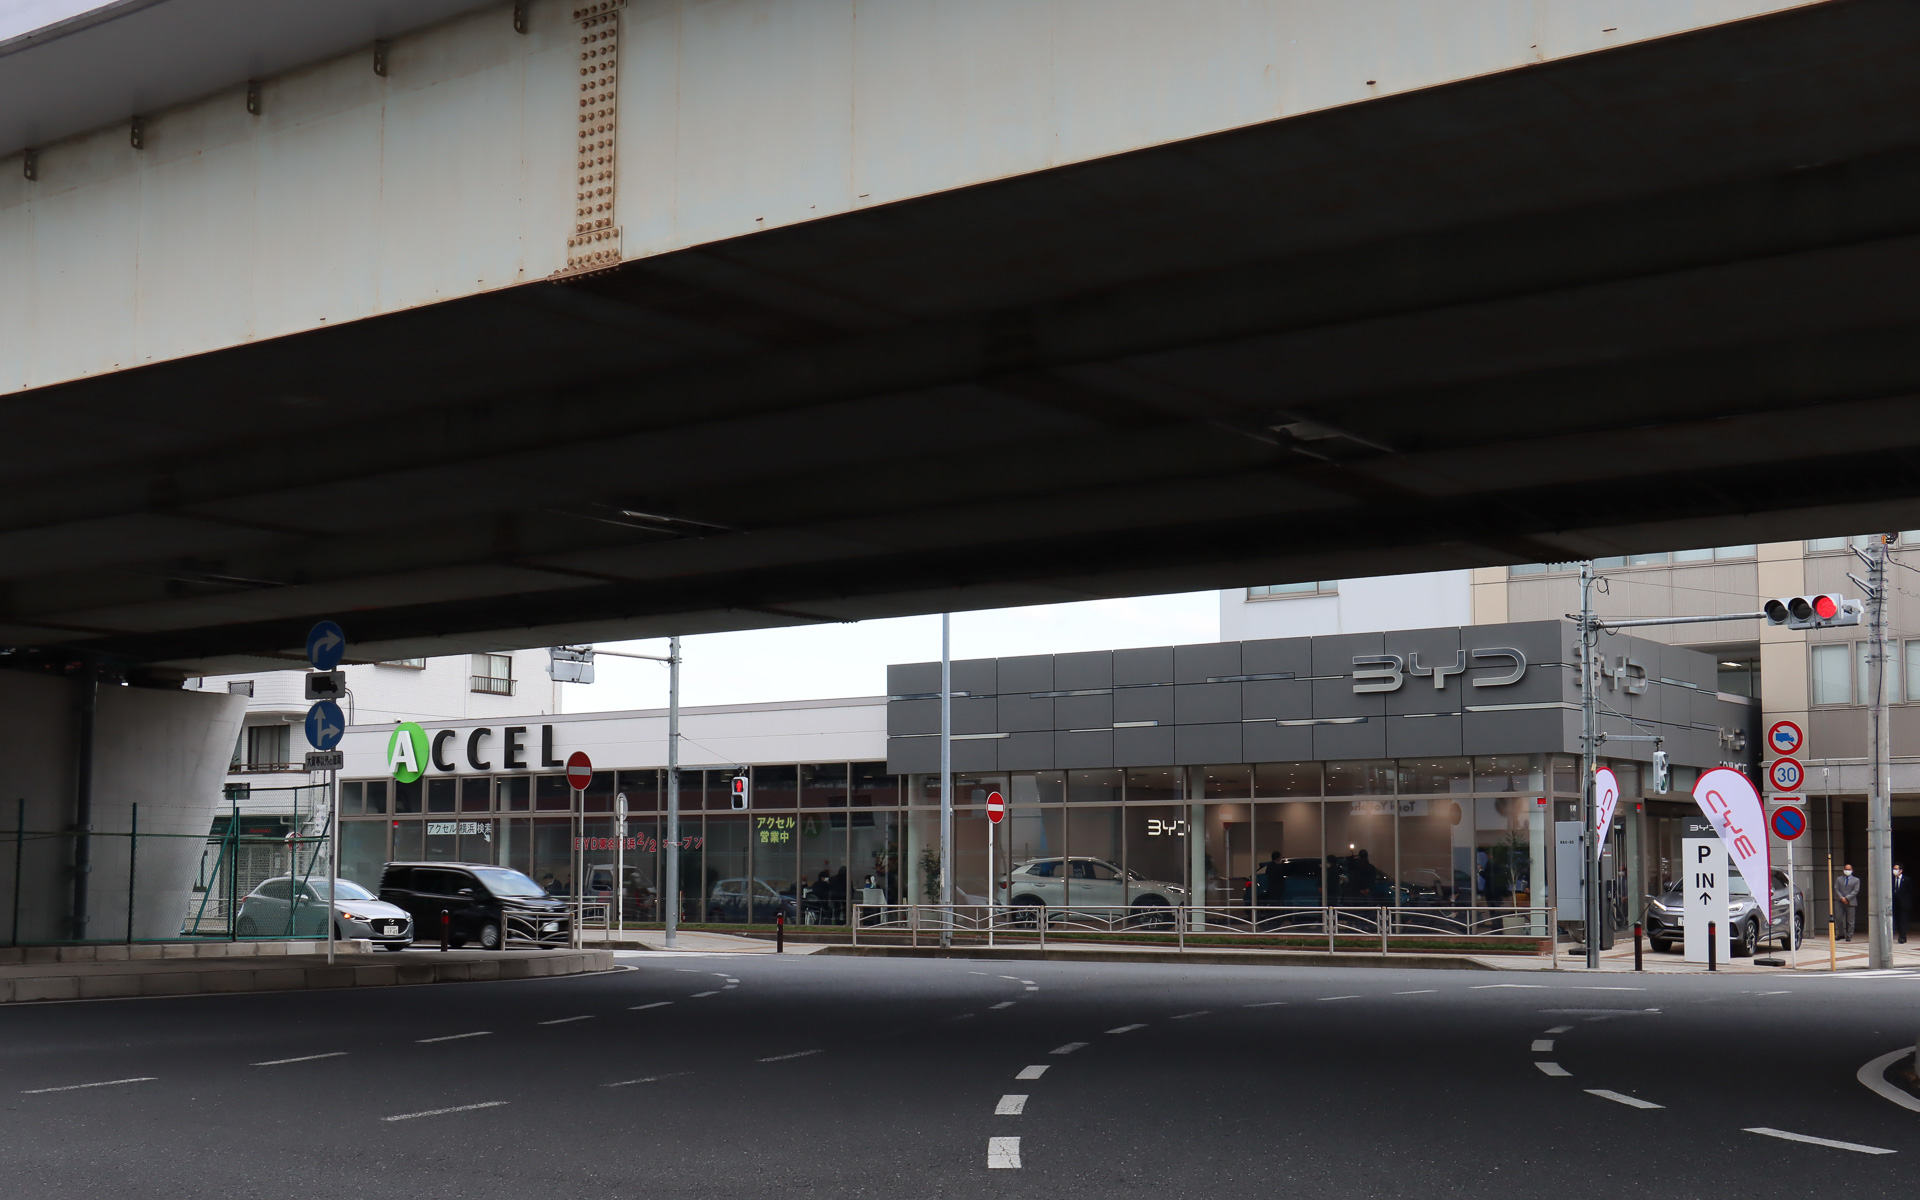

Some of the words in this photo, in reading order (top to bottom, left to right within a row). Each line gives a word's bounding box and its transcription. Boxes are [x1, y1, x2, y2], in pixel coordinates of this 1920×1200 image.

[1352, 647, 1527, 693] BYD
[389, 724, 564, 773] ACCEL
[1777, 767, 1797, 782] 30
[428, 824, 457, 834] アクセル
[460, 823, 476, 834] 横浜
[757, 816, 796, 829] アクセル
[804, 816, 817, 835] A
[1148, 819, 1191, 836] BYD
[1706, 790, 1757, 860] BYD
[760, 830, 790, 843] 営業中
[1698, 846, 1711, 863] P
[1696, 873, 1715, 888] IN
